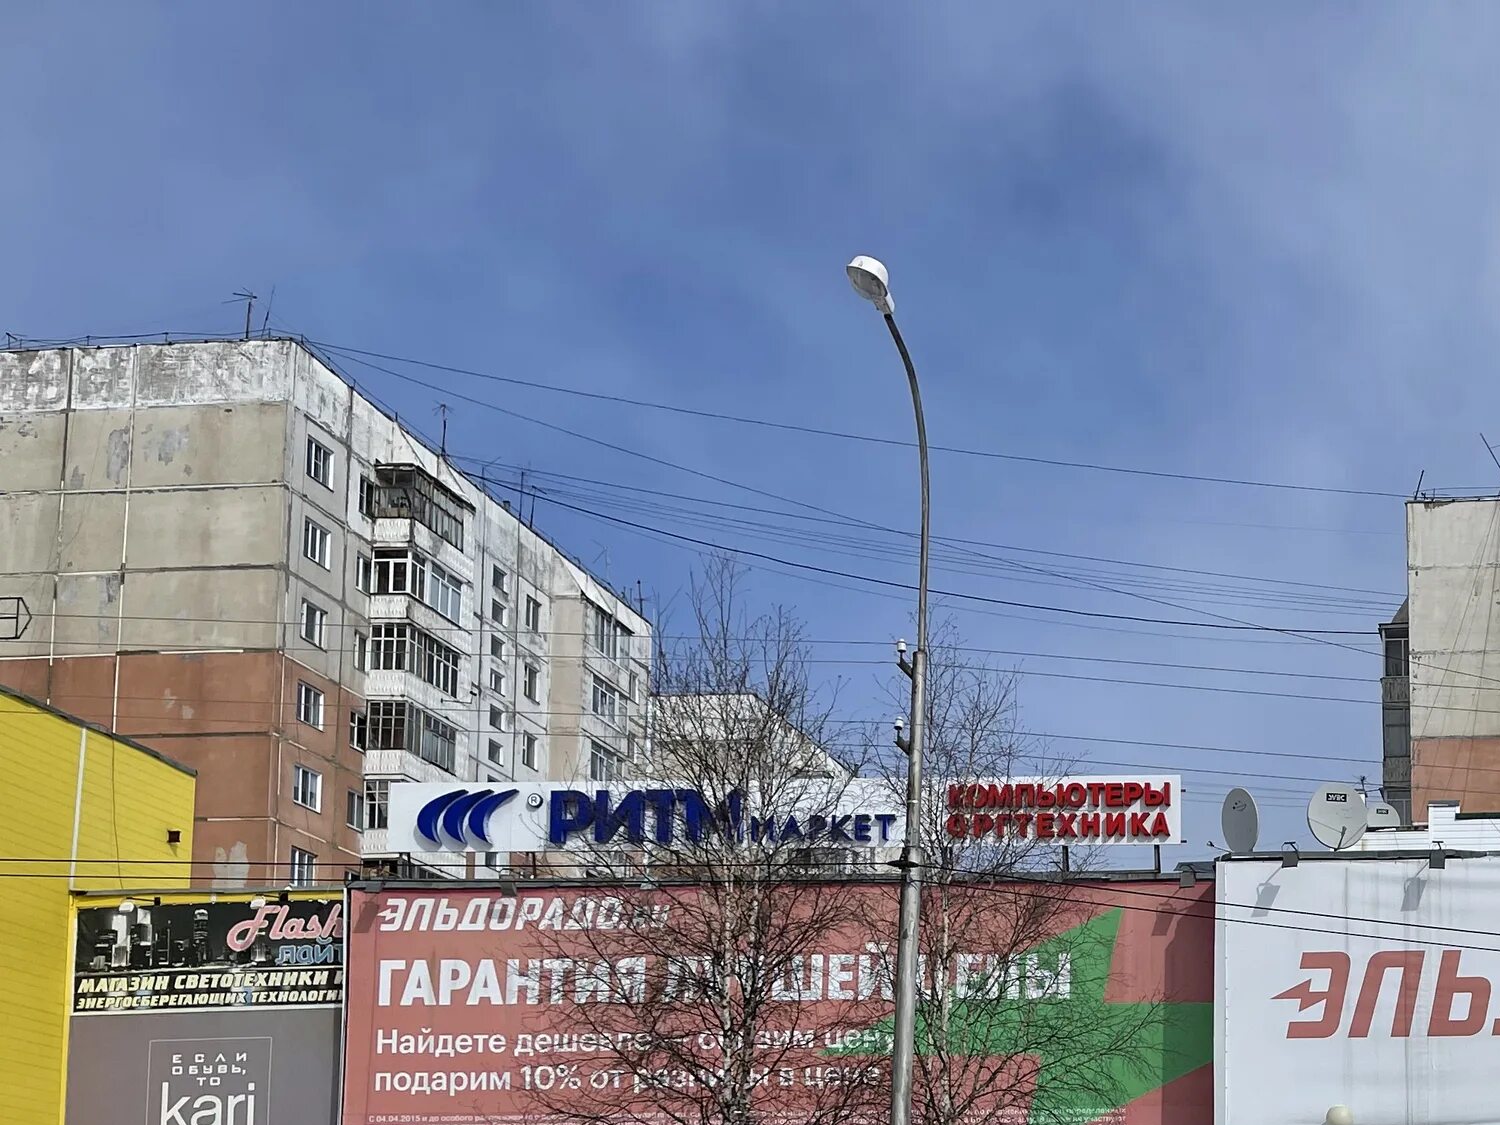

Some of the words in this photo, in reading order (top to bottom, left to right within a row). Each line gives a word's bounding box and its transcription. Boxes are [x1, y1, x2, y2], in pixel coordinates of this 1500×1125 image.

[948, 782, 1171, 808] КОМПЬЮТЕРЫ
[750, 813, 896, 843] МАРКЕТ
[946, 812, 1170, 838] ОРГТЕХНИКА
[227, 903, 343, 951] Flash
[78, 975, 170, 993] МАГАЗИН
[174, 971, 327, 989] СВЕТОТЕХНИКИ
[378, 957, 647, 1006] ГАРАНТИЯ
[76, 993, 247, 1010] ЭНЕРГОСБЕРЕГАЮЩИХ
[251, 989, 343, 1004] ТЕХНОЛОГИ
[376, 1028, 506, 1057] Найдете
[171, 1064, 247, 1076] ОБУВЬ,
[172, 1053, 247, 1064] ЕСЛИ
[196, 1076, 221, 1087] ТО
[374, 1070, 511, 1096] подарим
[520, 1064, 582, 1091] 10%
[590, 1069, 625, 1090] от
